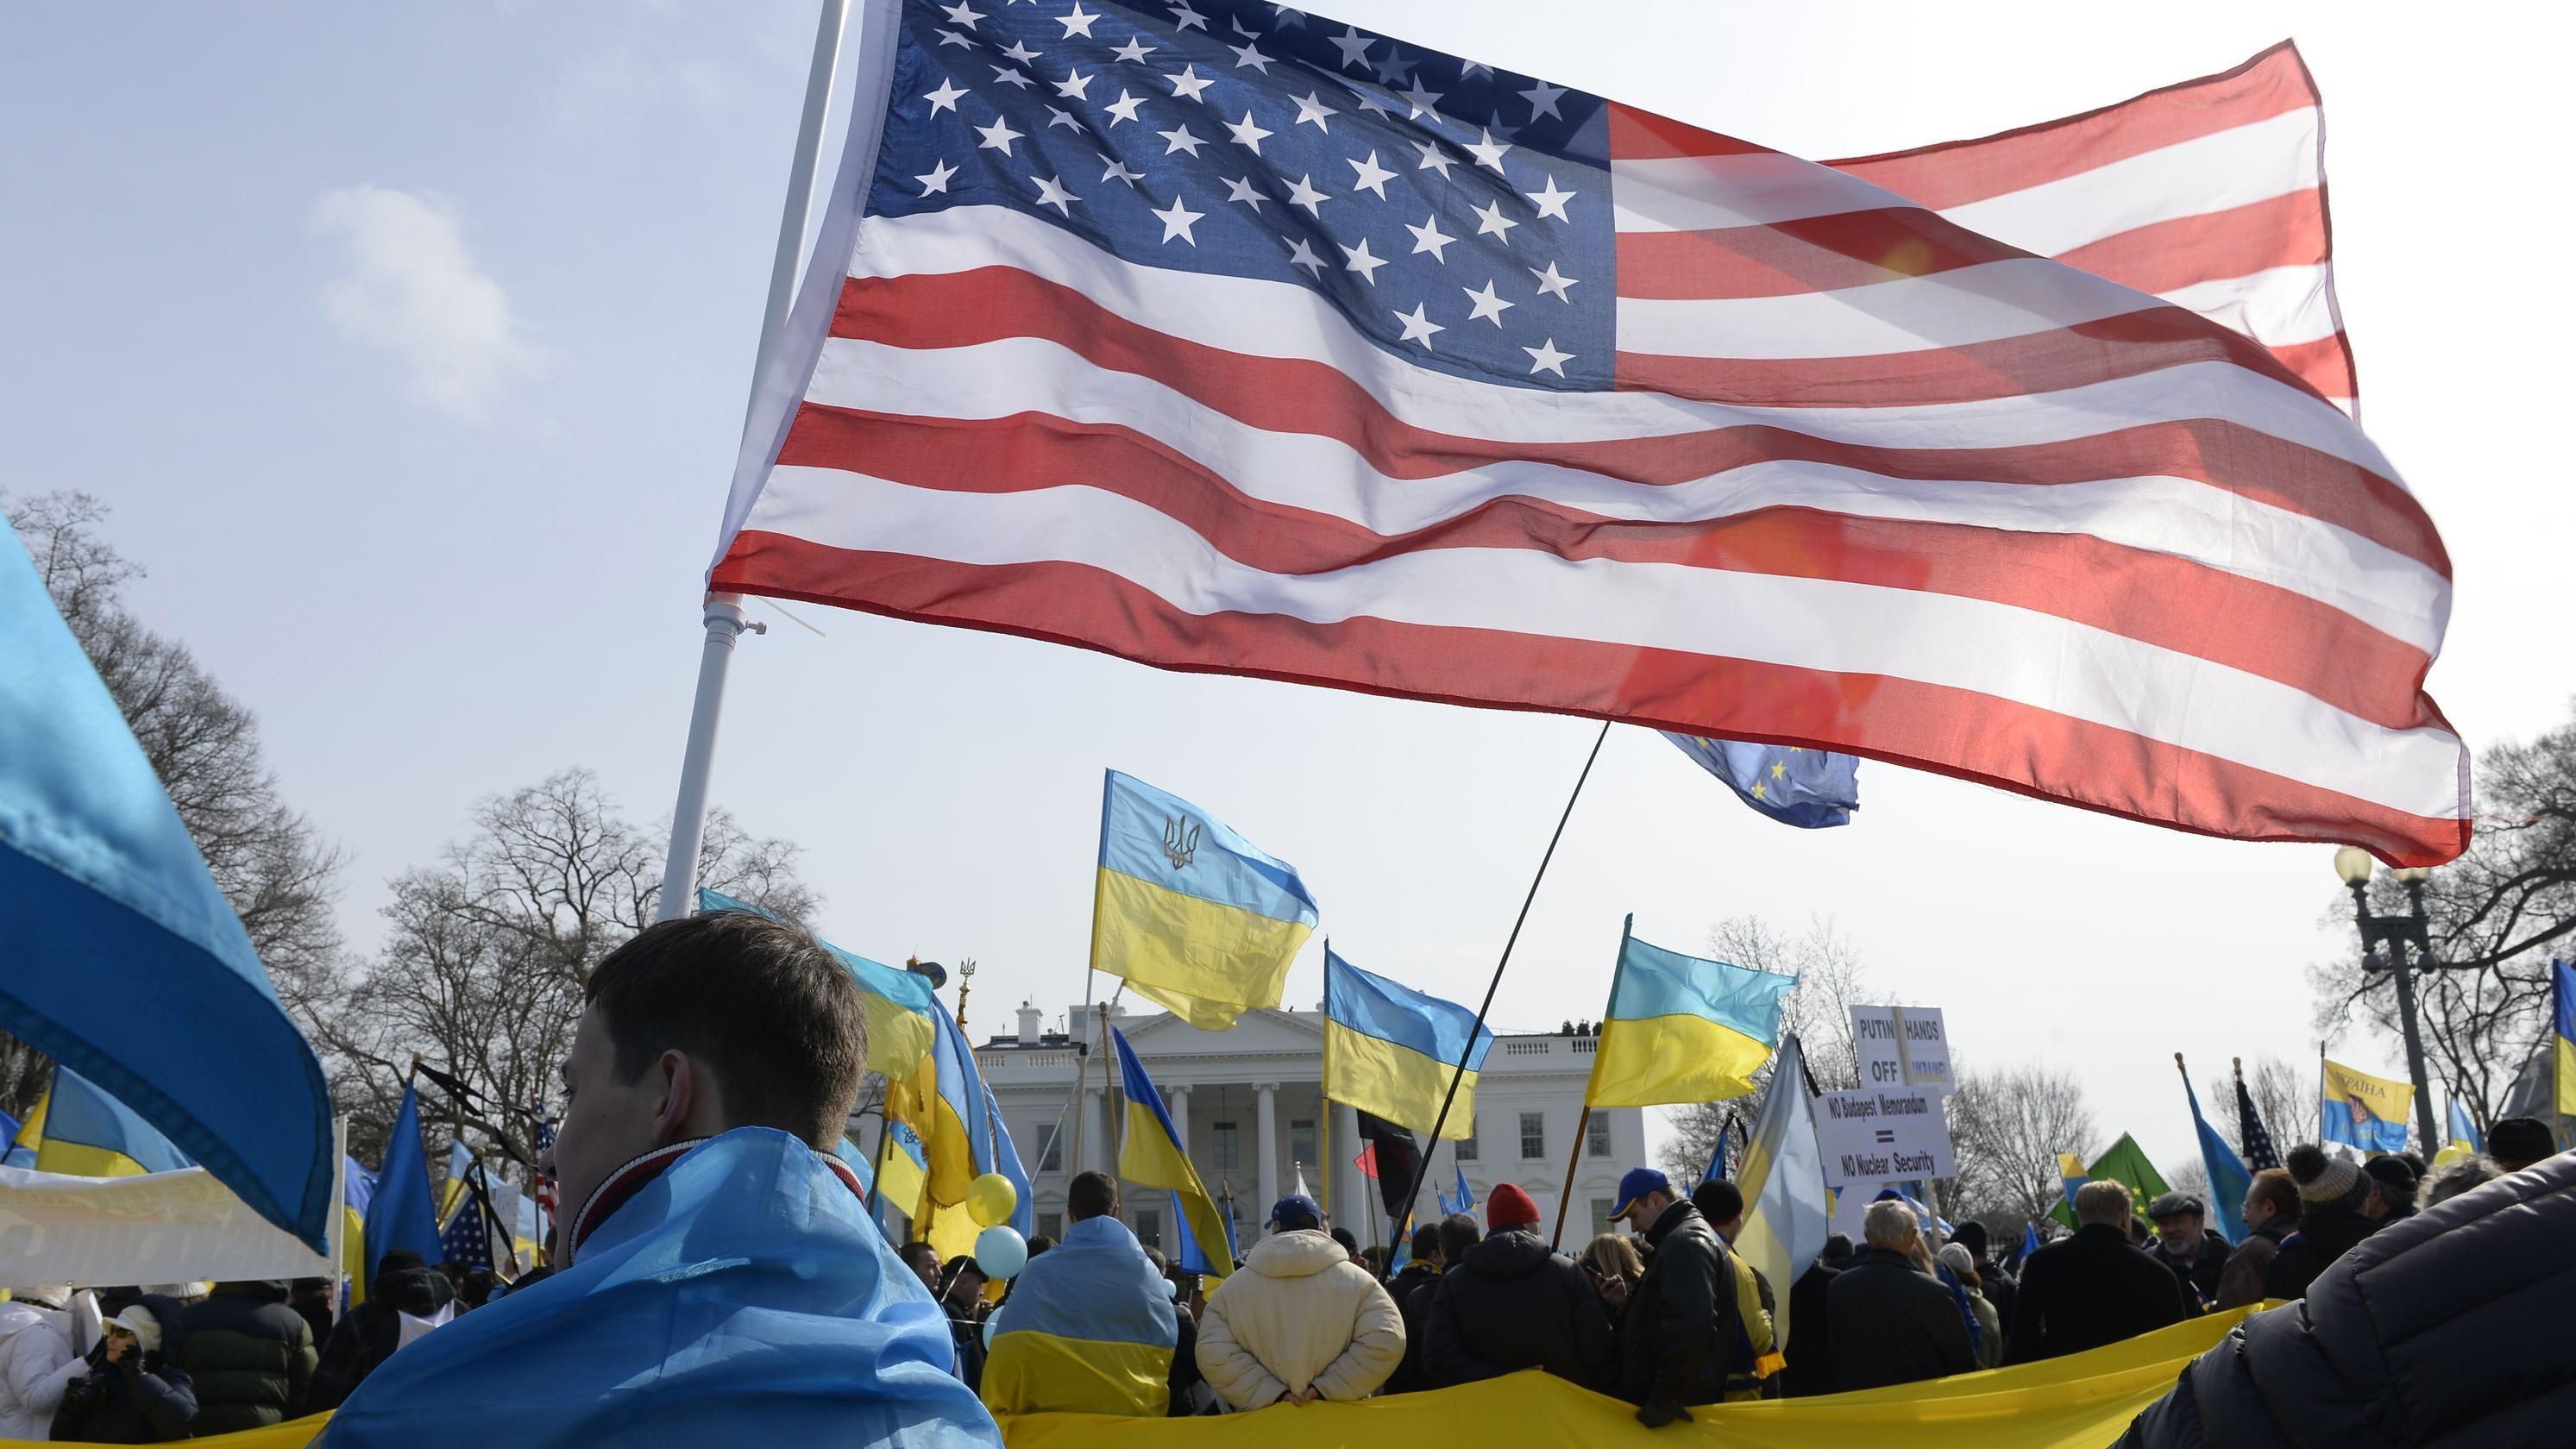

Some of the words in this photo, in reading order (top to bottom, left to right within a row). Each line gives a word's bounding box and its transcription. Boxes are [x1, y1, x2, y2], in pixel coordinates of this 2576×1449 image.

[1859, 1019, 1895, 1039] PUTIN
[1905, 1020, 1939, 1040] HANDS
[1872, 1061, 1897, 1082] OFF
[1828, 1096, 1841, 1119] NO
[1841, 1095, 1877, 1122] Budapest
[1879, 1093, 1928, 1116] Memorandum
[1841, 1154, 1857, 1177] NO
[1857, 1151, 1889, 1176] Nuclear
[1894, 1150, 1935, 1175] Security
